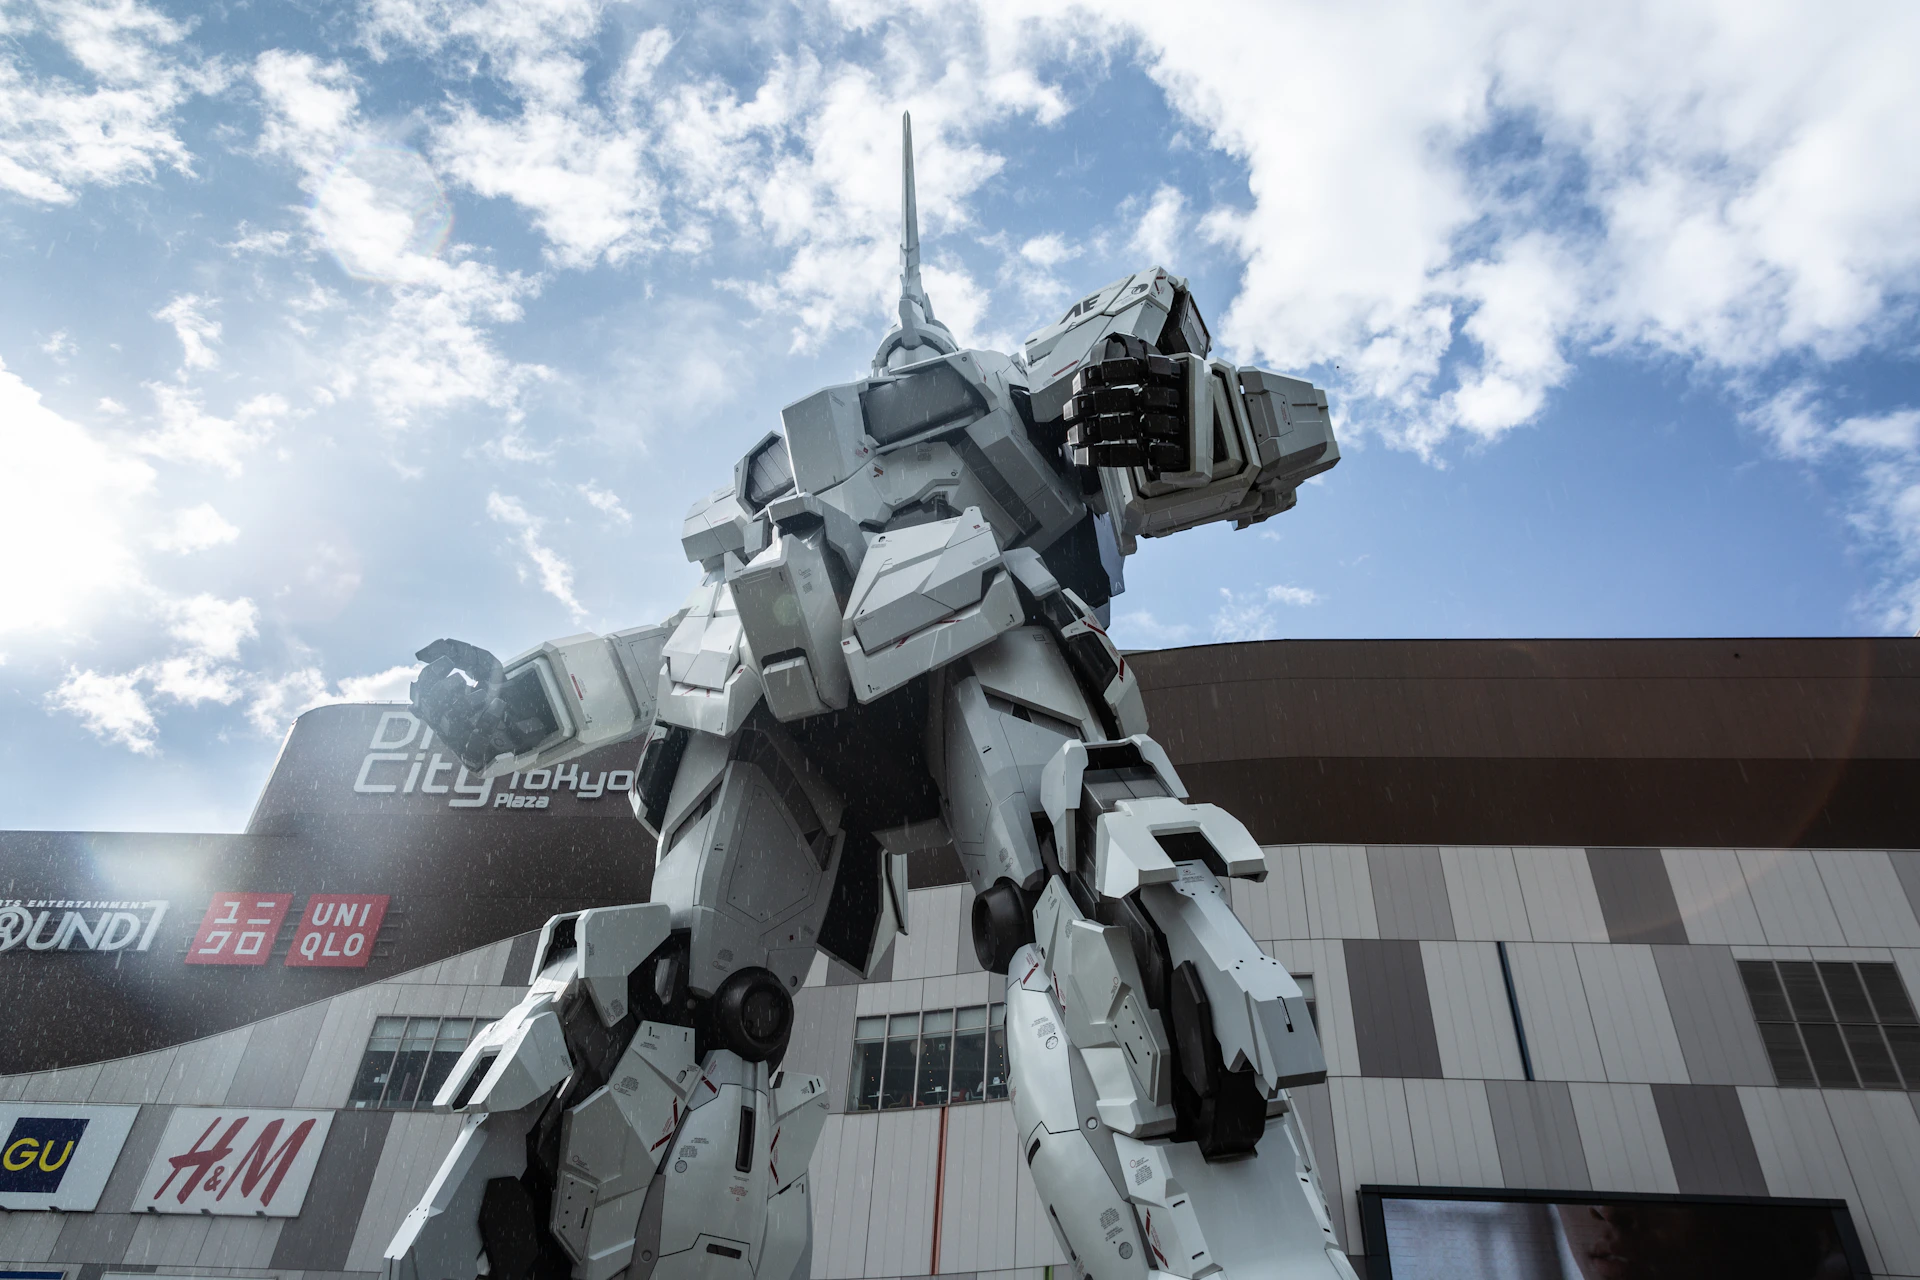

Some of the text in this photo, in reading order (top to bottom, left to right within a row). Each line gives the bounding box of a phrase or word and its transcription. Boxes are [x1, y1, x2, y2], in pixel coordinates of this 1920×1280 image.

[353, 753, 494, 807] City
[493, 793, 550, 809] Plaza
[27, 900, 149, 910] ENTERTAINMENT
[214, 901, 276, 924] ユニ
[311, 902, 371, 927] UNI
[198, 931, 266, 955] クロ
[300, 932, 365, 961] QLO
[2, 1137, 75, 1172] GU
[154, 1116, 316, 1207] H&M
